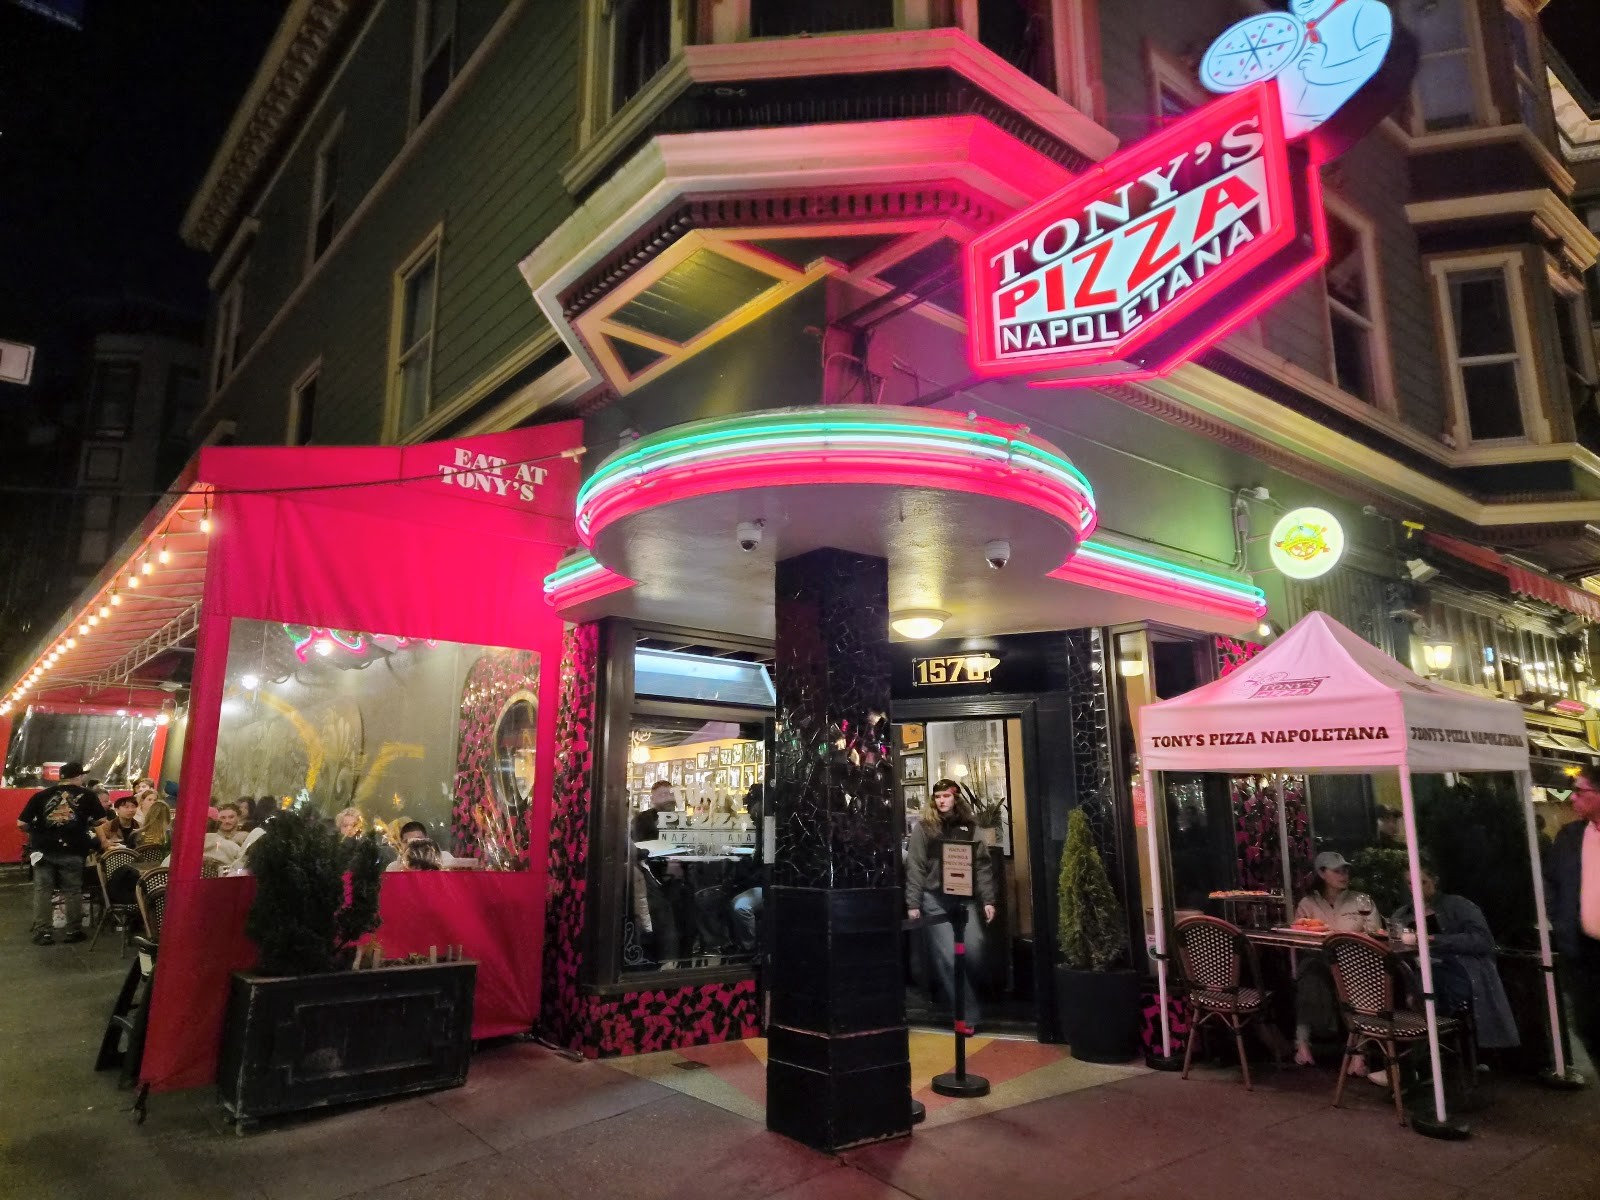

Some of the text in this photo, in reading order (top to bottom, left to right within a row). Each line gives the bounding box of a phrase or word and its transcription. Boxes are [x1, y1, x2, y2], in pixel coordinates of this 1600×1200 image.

[990, 115, 1265, 286] TONY'S
[999, 174, 1260, 320] PIZZA
[1002, 218, 1255, 351] NAPOLETANA
[438, 464, 535, 502] TONY'S
[453, 447, 548, 486] EAT AT
[1151, 726, 1390, 748] TONY'S PIZZA NAPOLETANA
[1410, 726, 1445, 742] TONY'S
